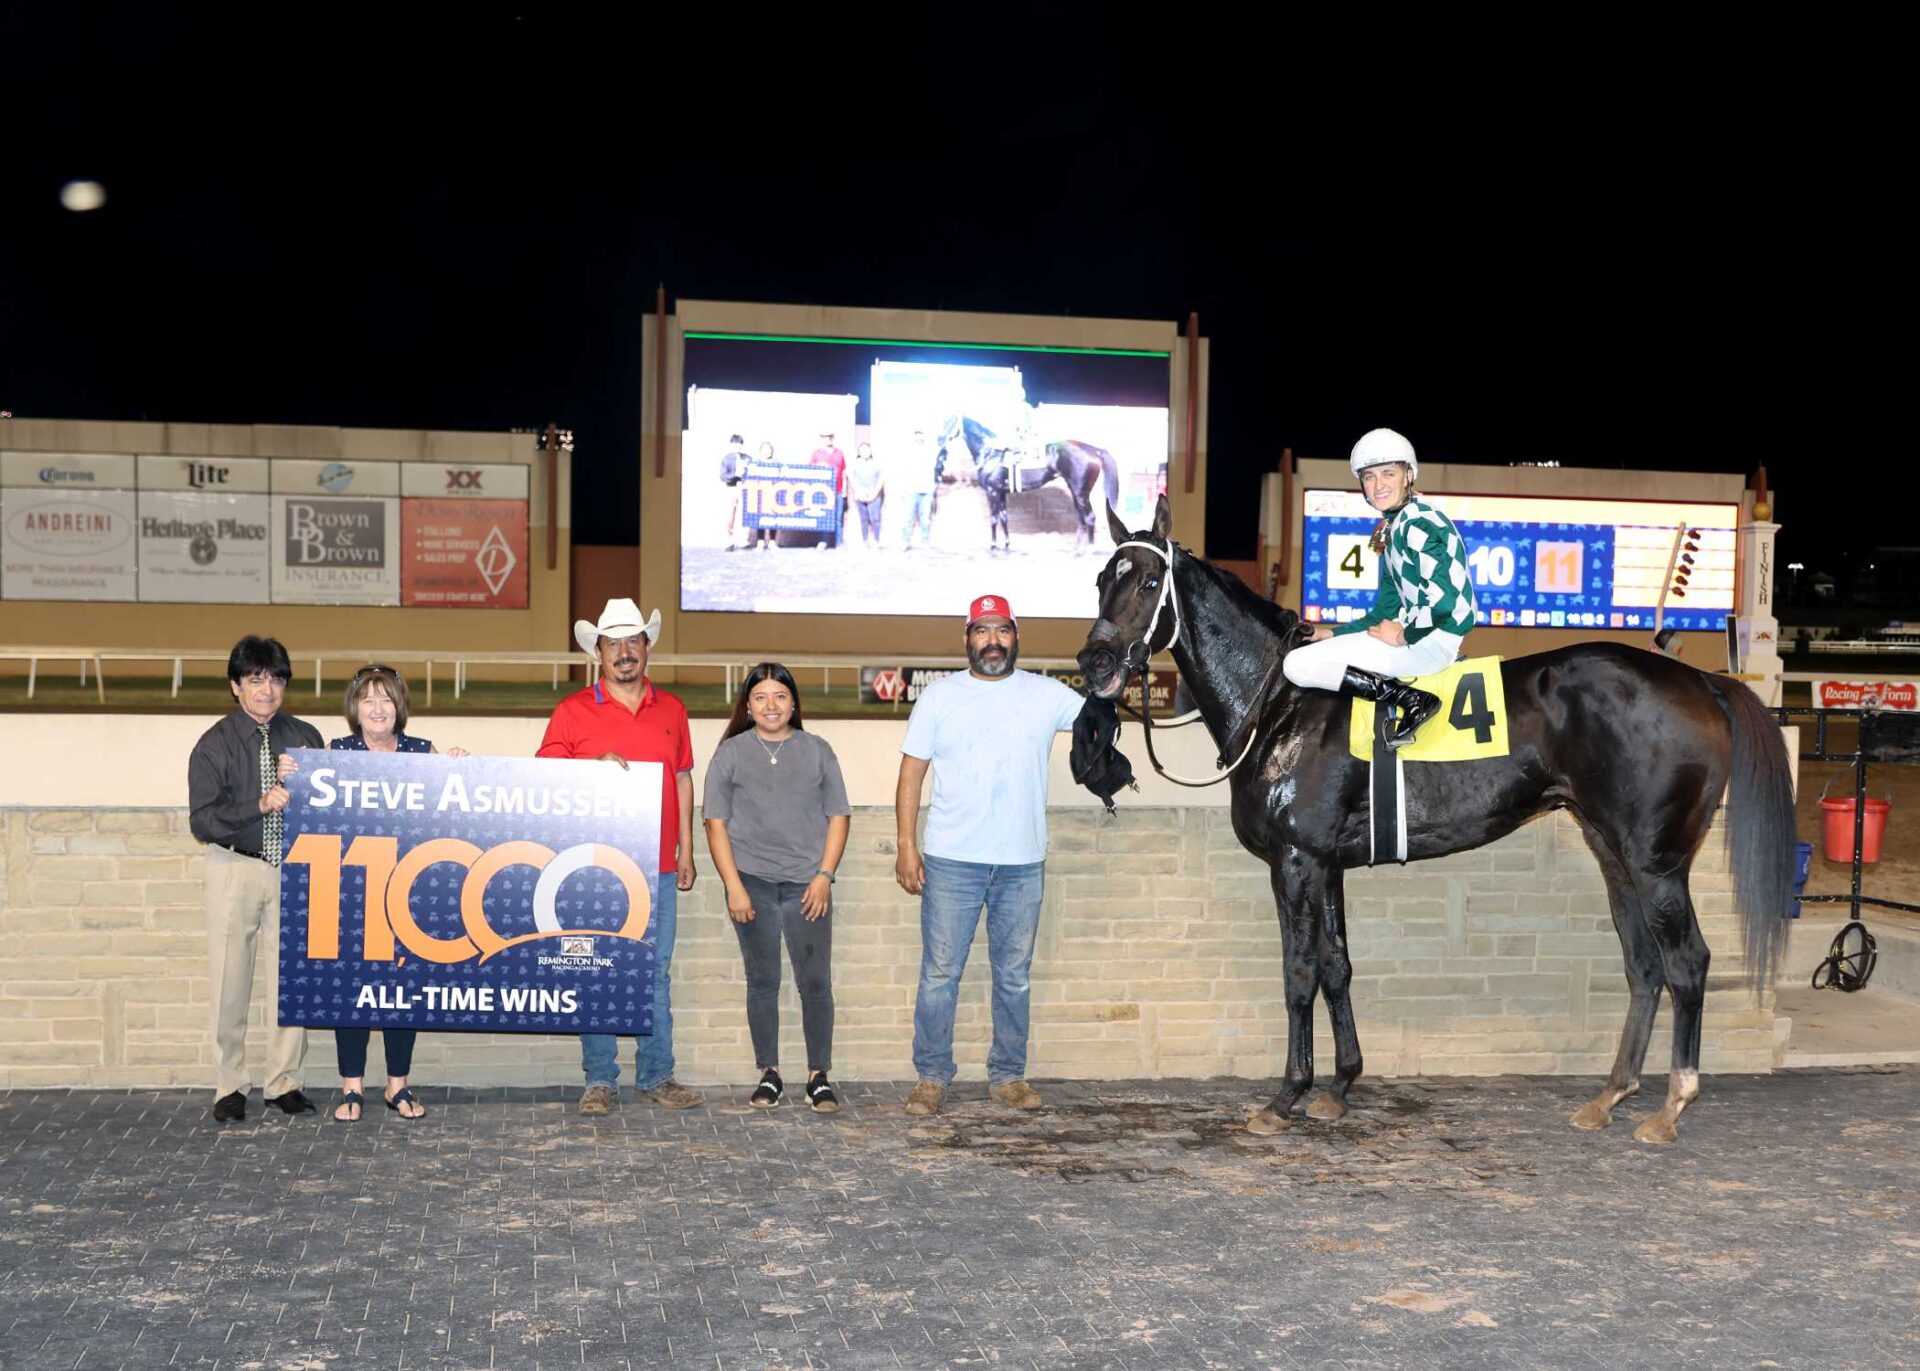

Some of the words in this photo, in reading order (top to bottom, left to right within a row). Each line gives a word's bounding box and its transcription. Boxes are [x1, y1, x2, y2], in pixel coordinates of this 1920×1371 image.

[188, 463, 230, 488] Lite
[445, 470, 484, 489] XX
[25, 511, 112, 532] ANDREINI
[142, 517, 215, 540] Heritage
[217, 518, 266, 541] Place
[288, 503, 370, 541] Brown
[298, 527, 380, 563] Brown
[335, 528, 355, 546] &
[1340, 544, 1365, 579] 4
[1468, 545, 1515, 586] 10
[1539, 549, 1578, 587] 11
[1759, 542, 1769, 605] FINISH
[1150, 687, 1170, 699] OAK
[1825, 686, 1860, 702] Racing
[1448, 672, 1496, 744] 4
[309, 768, 425, 811] STEVE
[538, 957, 591, 967] REMINGTON
[593, 958, 614, 967] PARK
[356, 985, 494, 1011] ALL-TIME
[501, 987, 578, 1014] WINS
